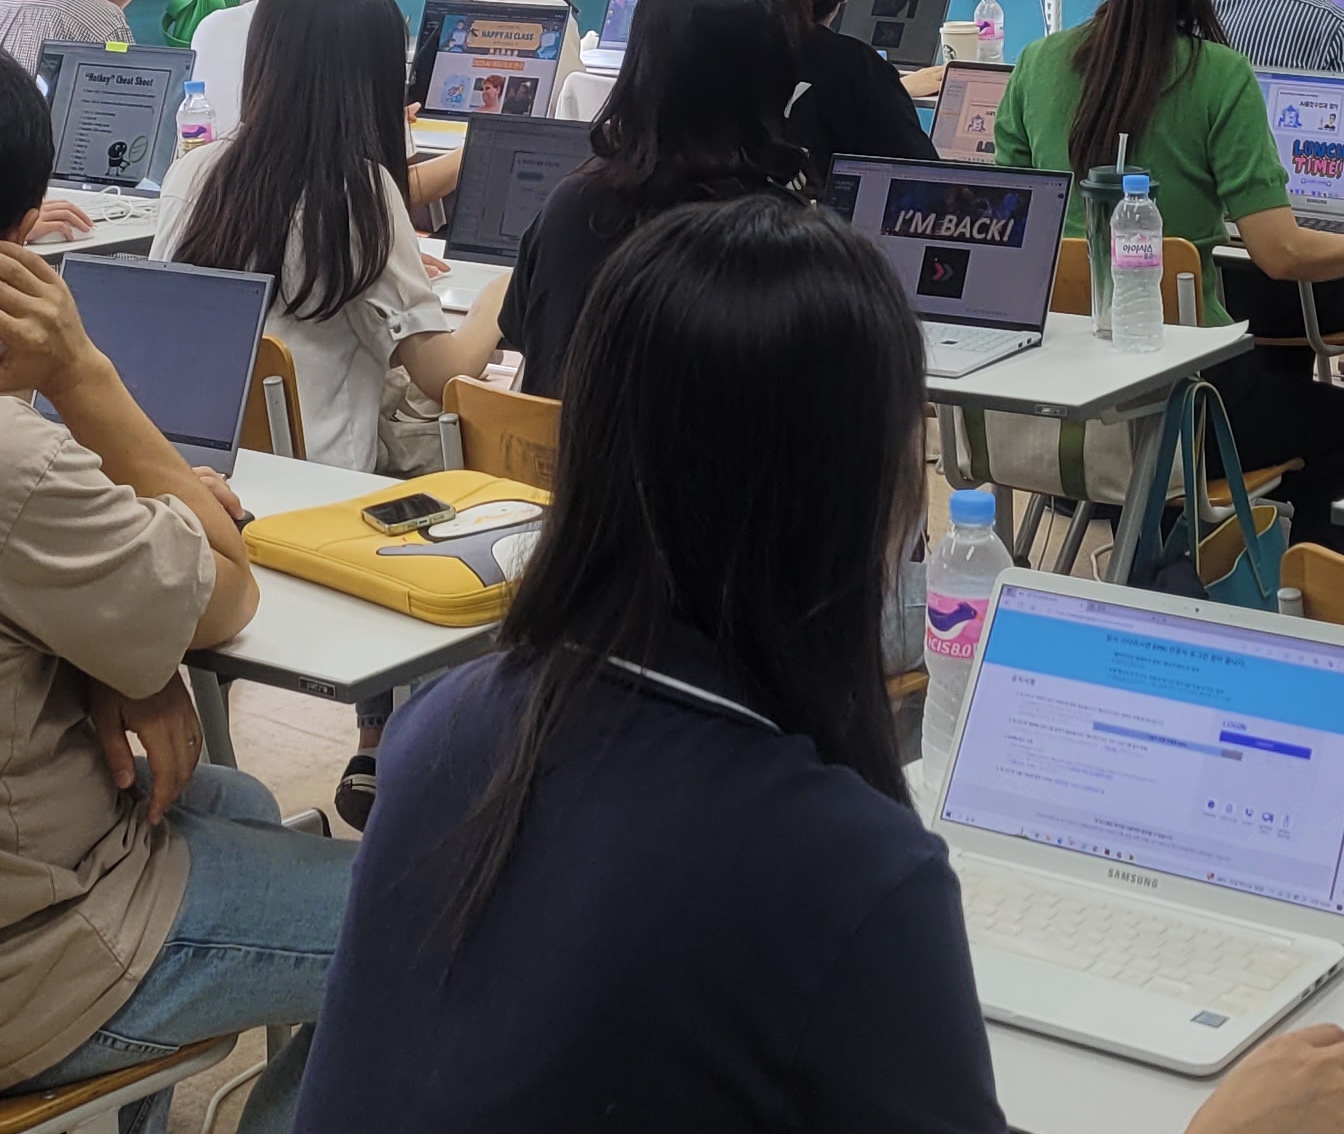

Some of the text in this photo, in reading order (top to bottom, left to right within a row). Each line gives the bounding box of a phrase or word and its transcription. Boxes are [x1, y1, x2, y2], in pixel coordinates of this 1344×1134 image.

[116, 74, 134, 85] Cheat
[135, 77, 154, 87] Sheet
[1292, 156, 1344, 179] TIME!
[939, 216, 1015, 243] BACK!
[1222, 719, 1248, 732] LOGIN
[1107, 868, 1159, 889] SAMSUNG
